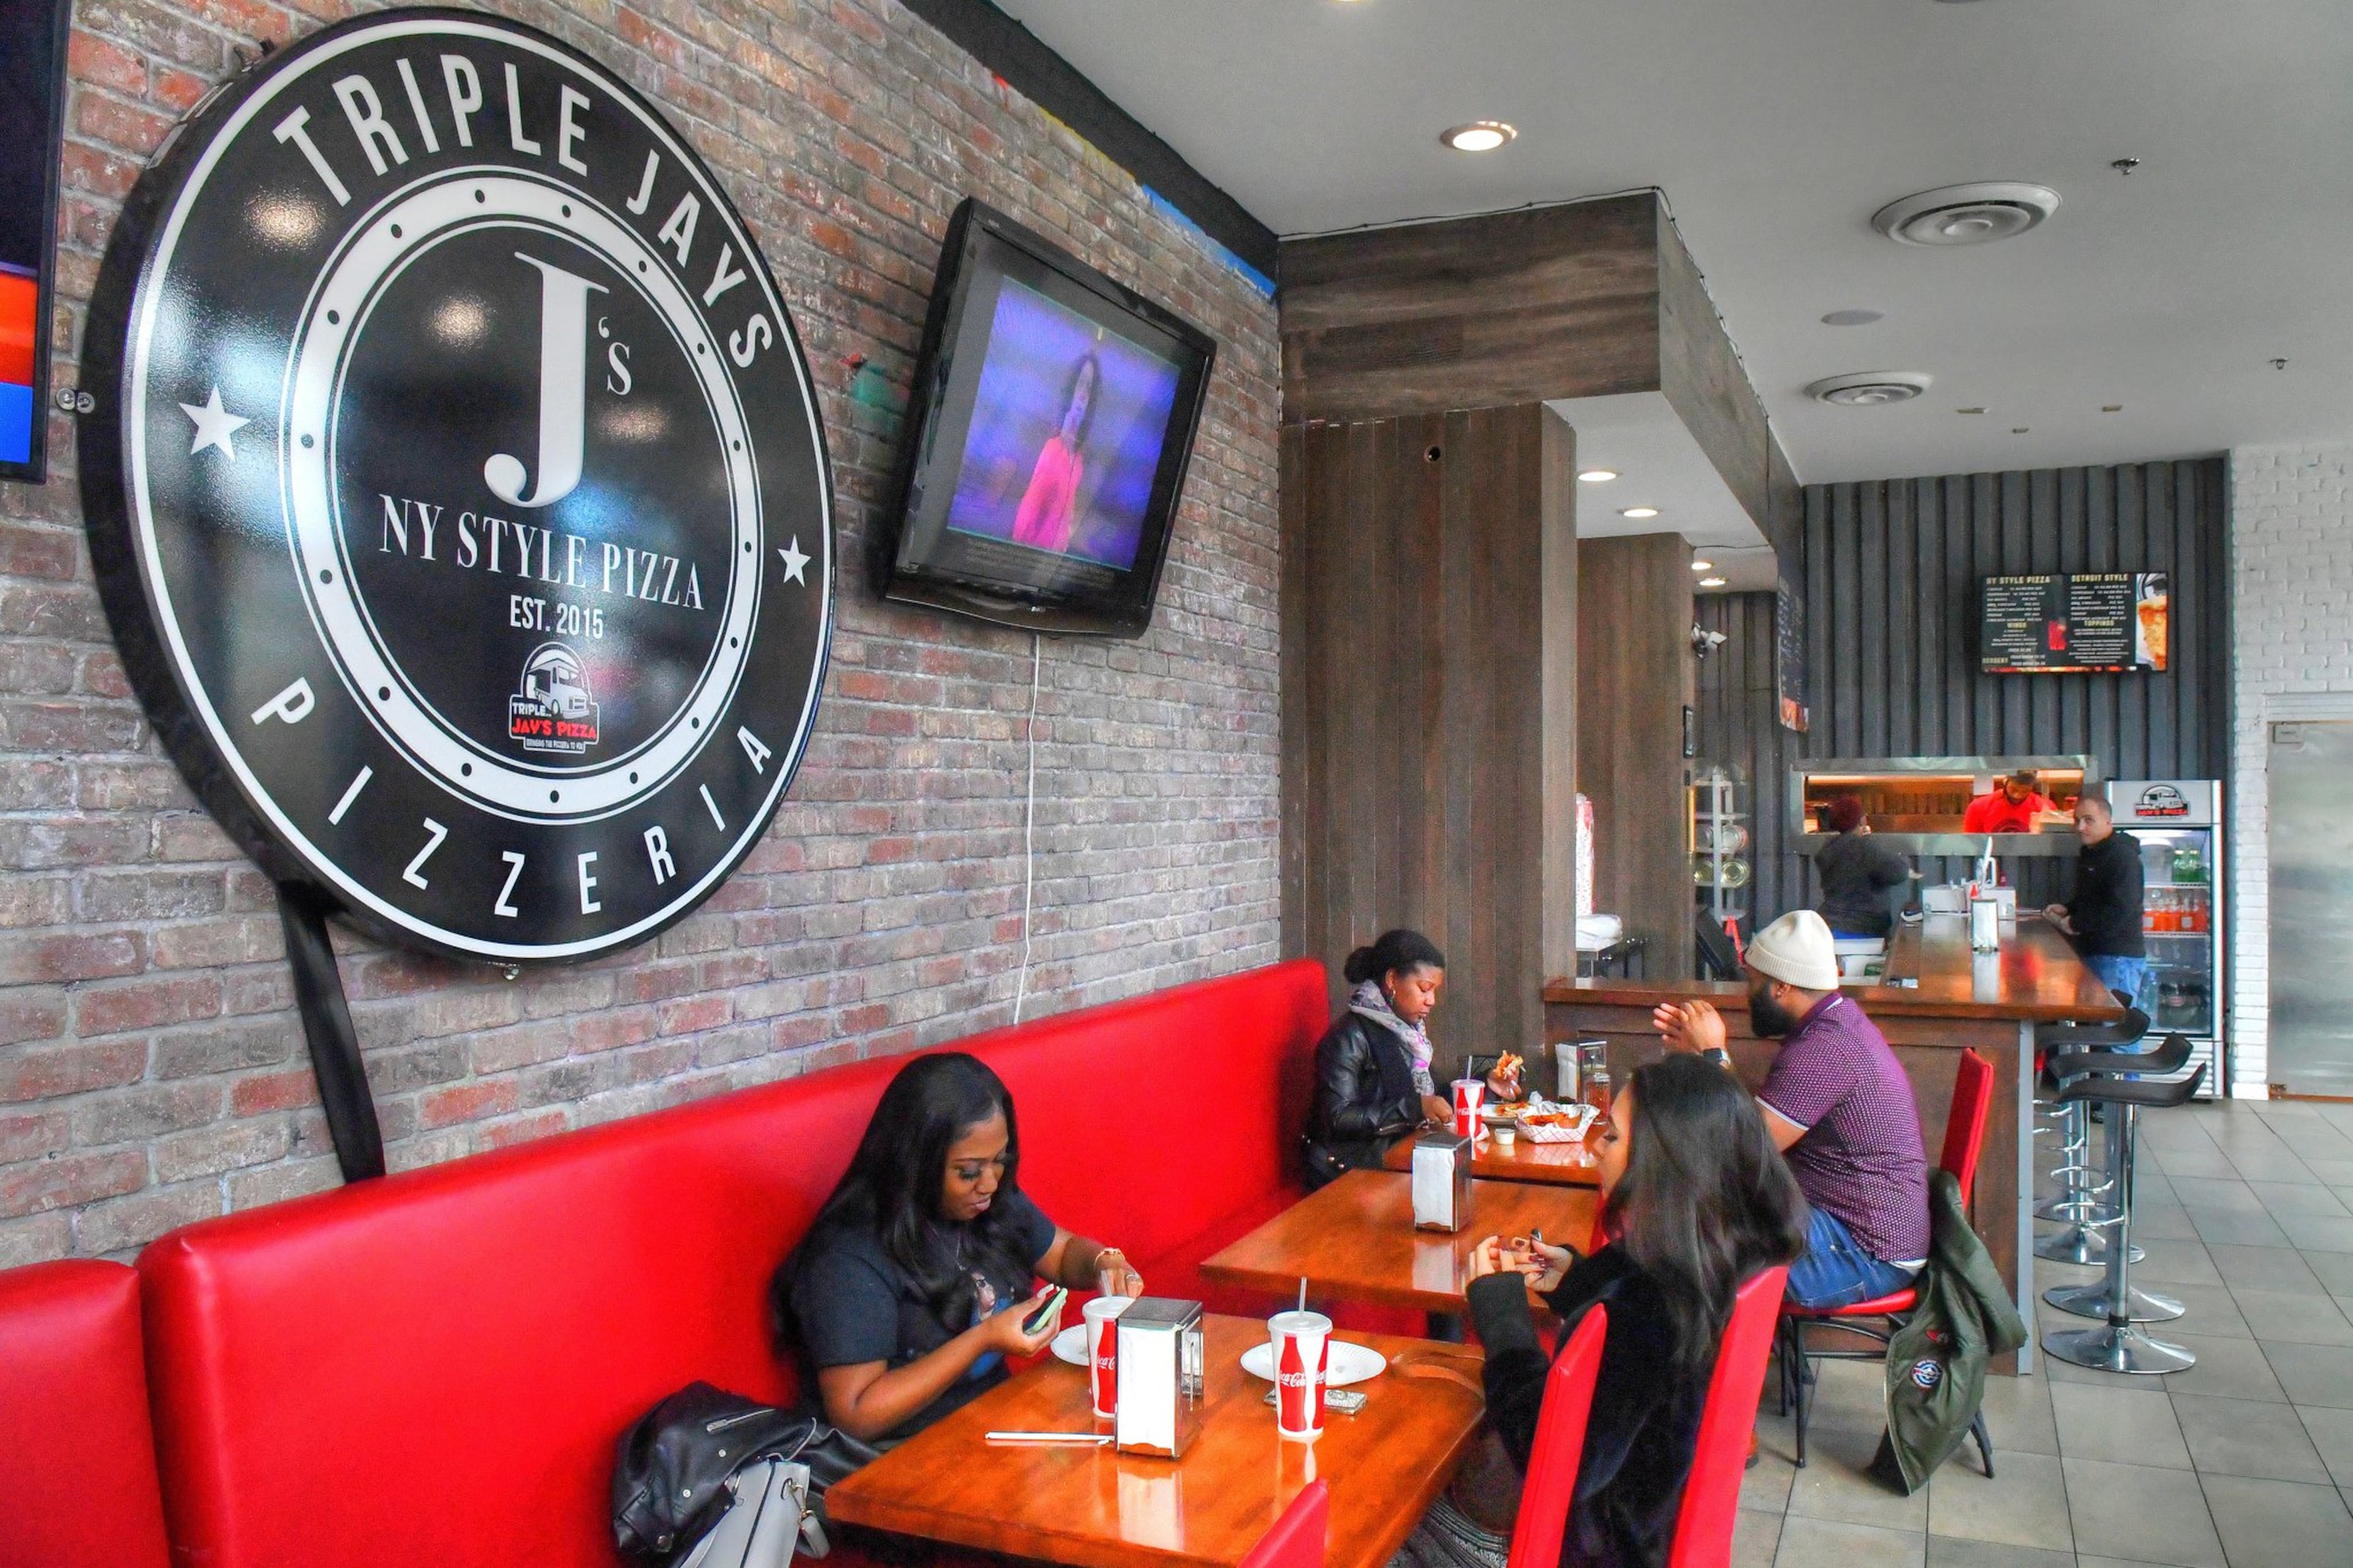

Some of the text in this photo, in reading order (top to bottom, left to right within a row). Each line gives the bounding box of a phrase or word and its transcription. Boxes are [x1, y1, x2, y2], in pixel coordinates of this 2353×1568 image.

[273, 54, 773, 369] TRIPLE JAYS
[379, 494, 704, 610] NY STYLE PIZZA
[2071, 574, 2102, 583] DETROIT
[510, 594, 604, 639] EST. 2015
[556, 721, 597, 740] PIZZA
[251, 676, 772, 918] PIZZERIA
